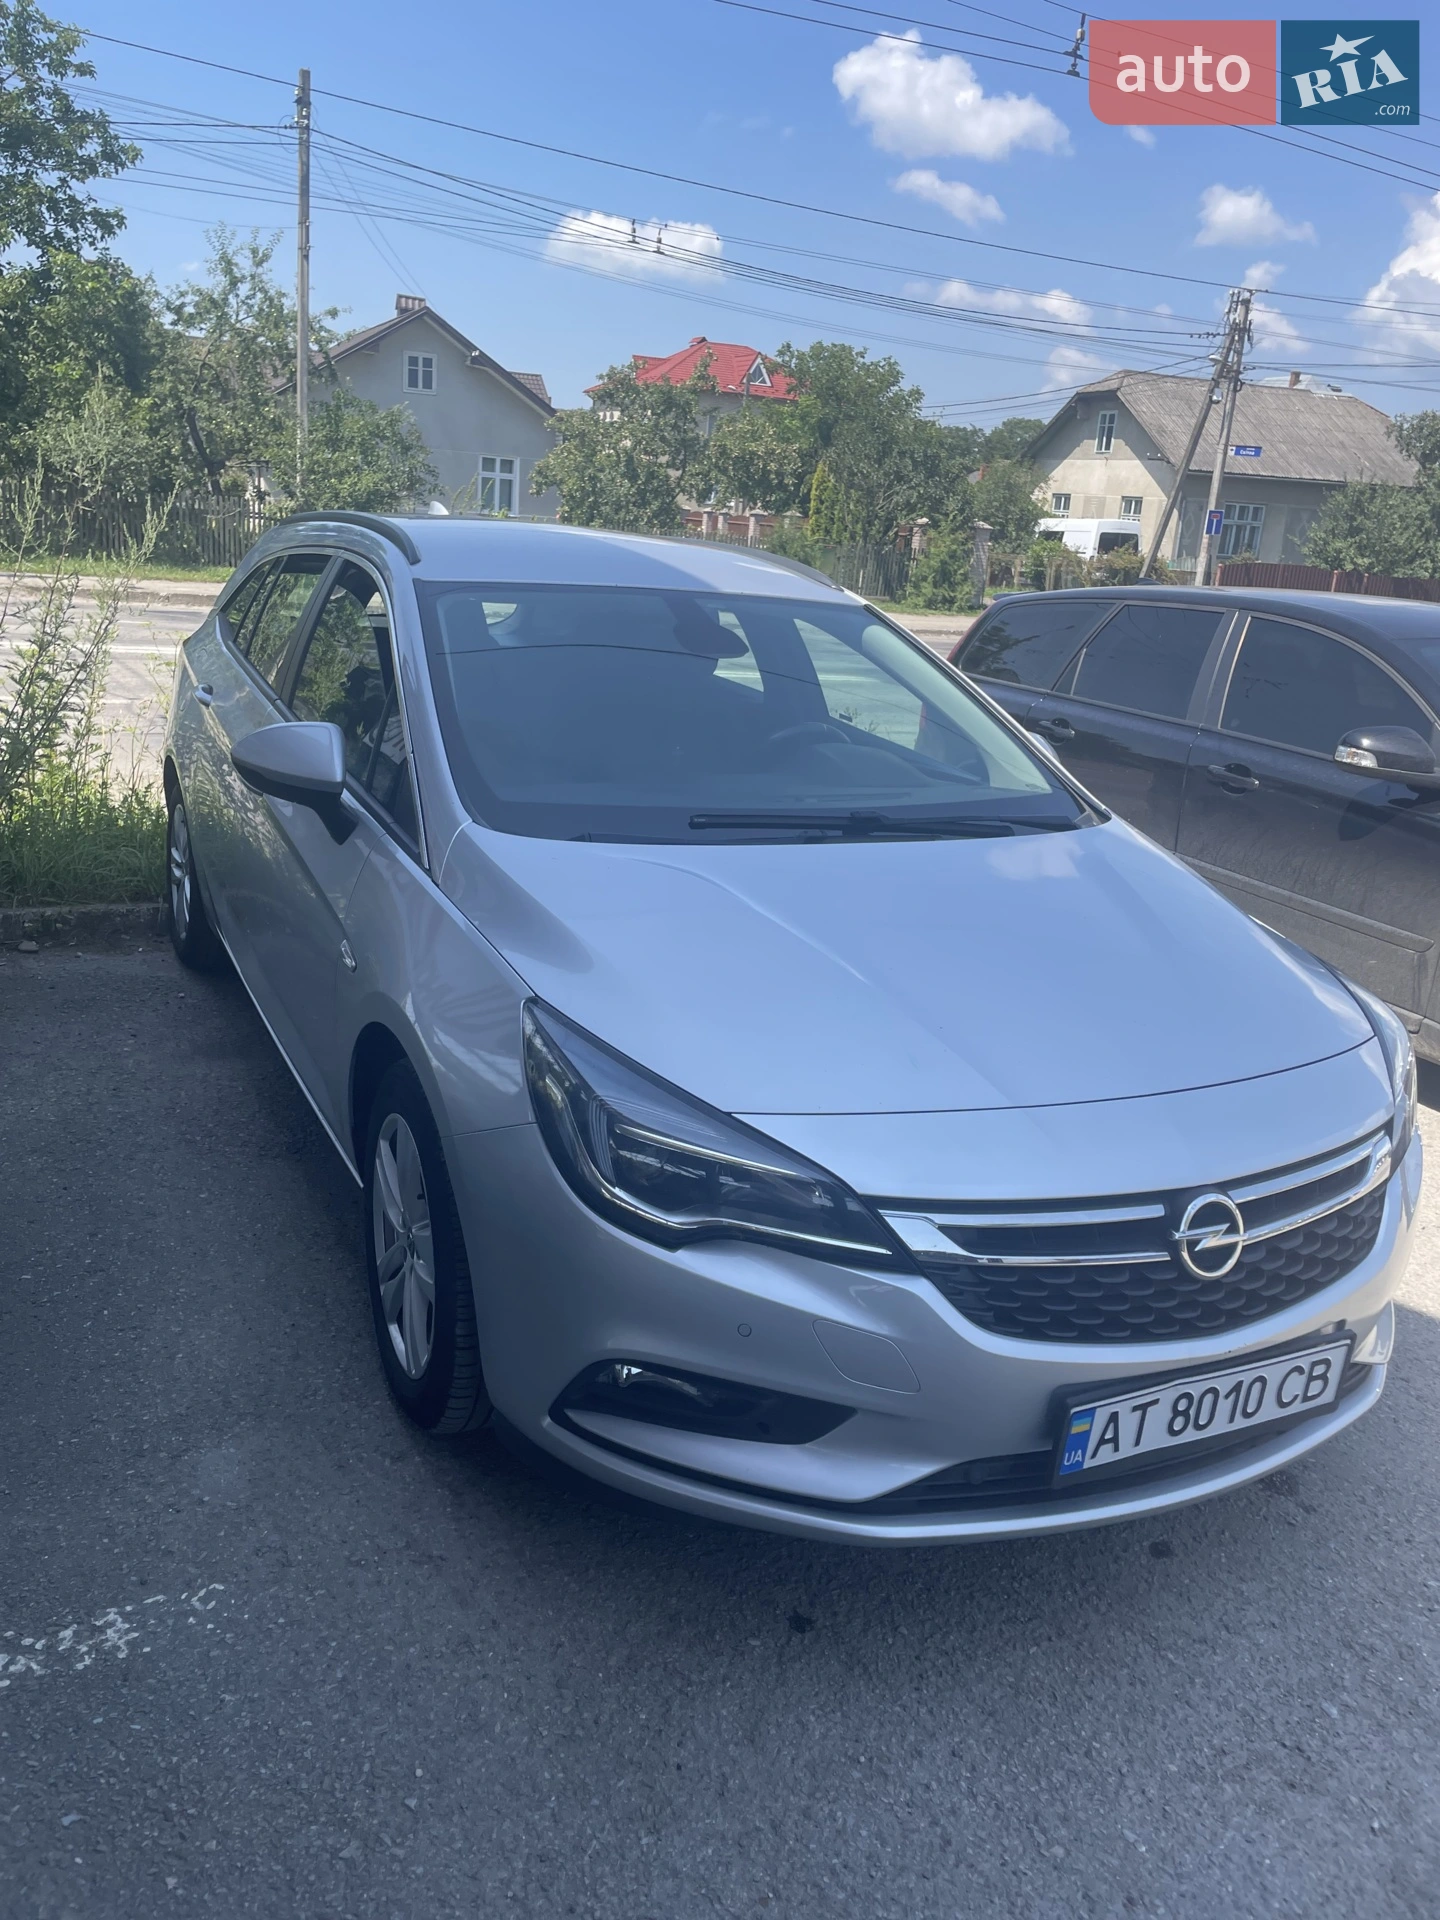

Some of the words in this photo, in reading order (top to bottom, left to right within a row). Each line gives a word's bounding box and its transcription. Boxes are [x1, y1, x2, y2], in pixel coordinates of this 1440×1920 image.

[1090, 1397, 1160, 1460] AT
[1167, 1374, 1268, 1438] 8010
[1275, 1357, 1332, 1409] CB
[1064, 1450, 1083, 1466] UA
